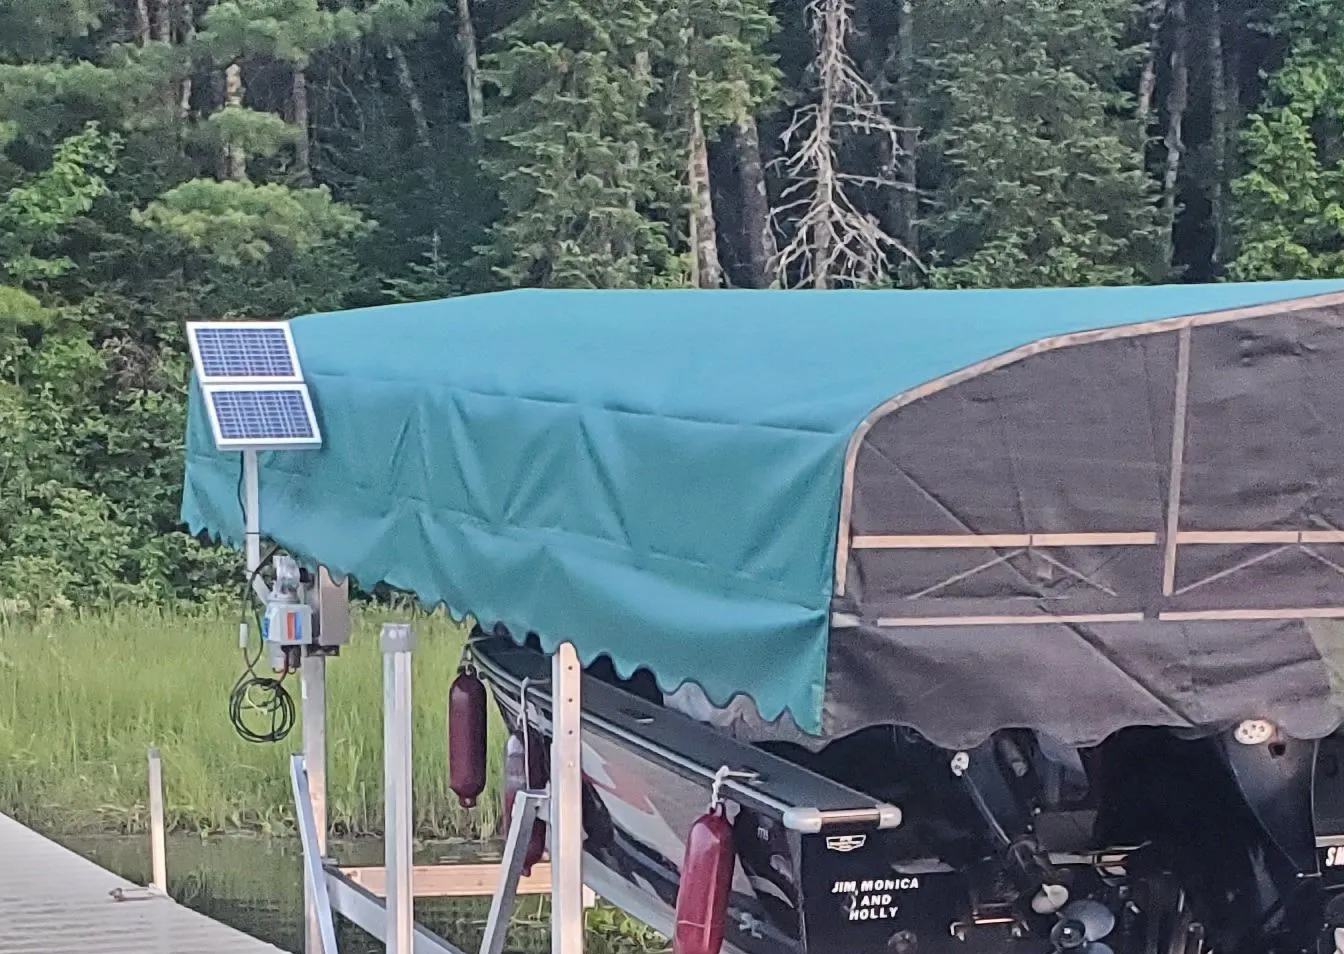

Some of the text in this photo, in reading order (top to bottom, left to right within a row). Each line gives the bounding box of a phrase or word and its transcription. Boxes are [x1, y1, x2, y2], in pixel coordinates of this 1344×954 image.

[861, 878, 919, 892] MONICA
[860, 894, 892, 907] AND
[849, 906, 899, 921] HOLLY
